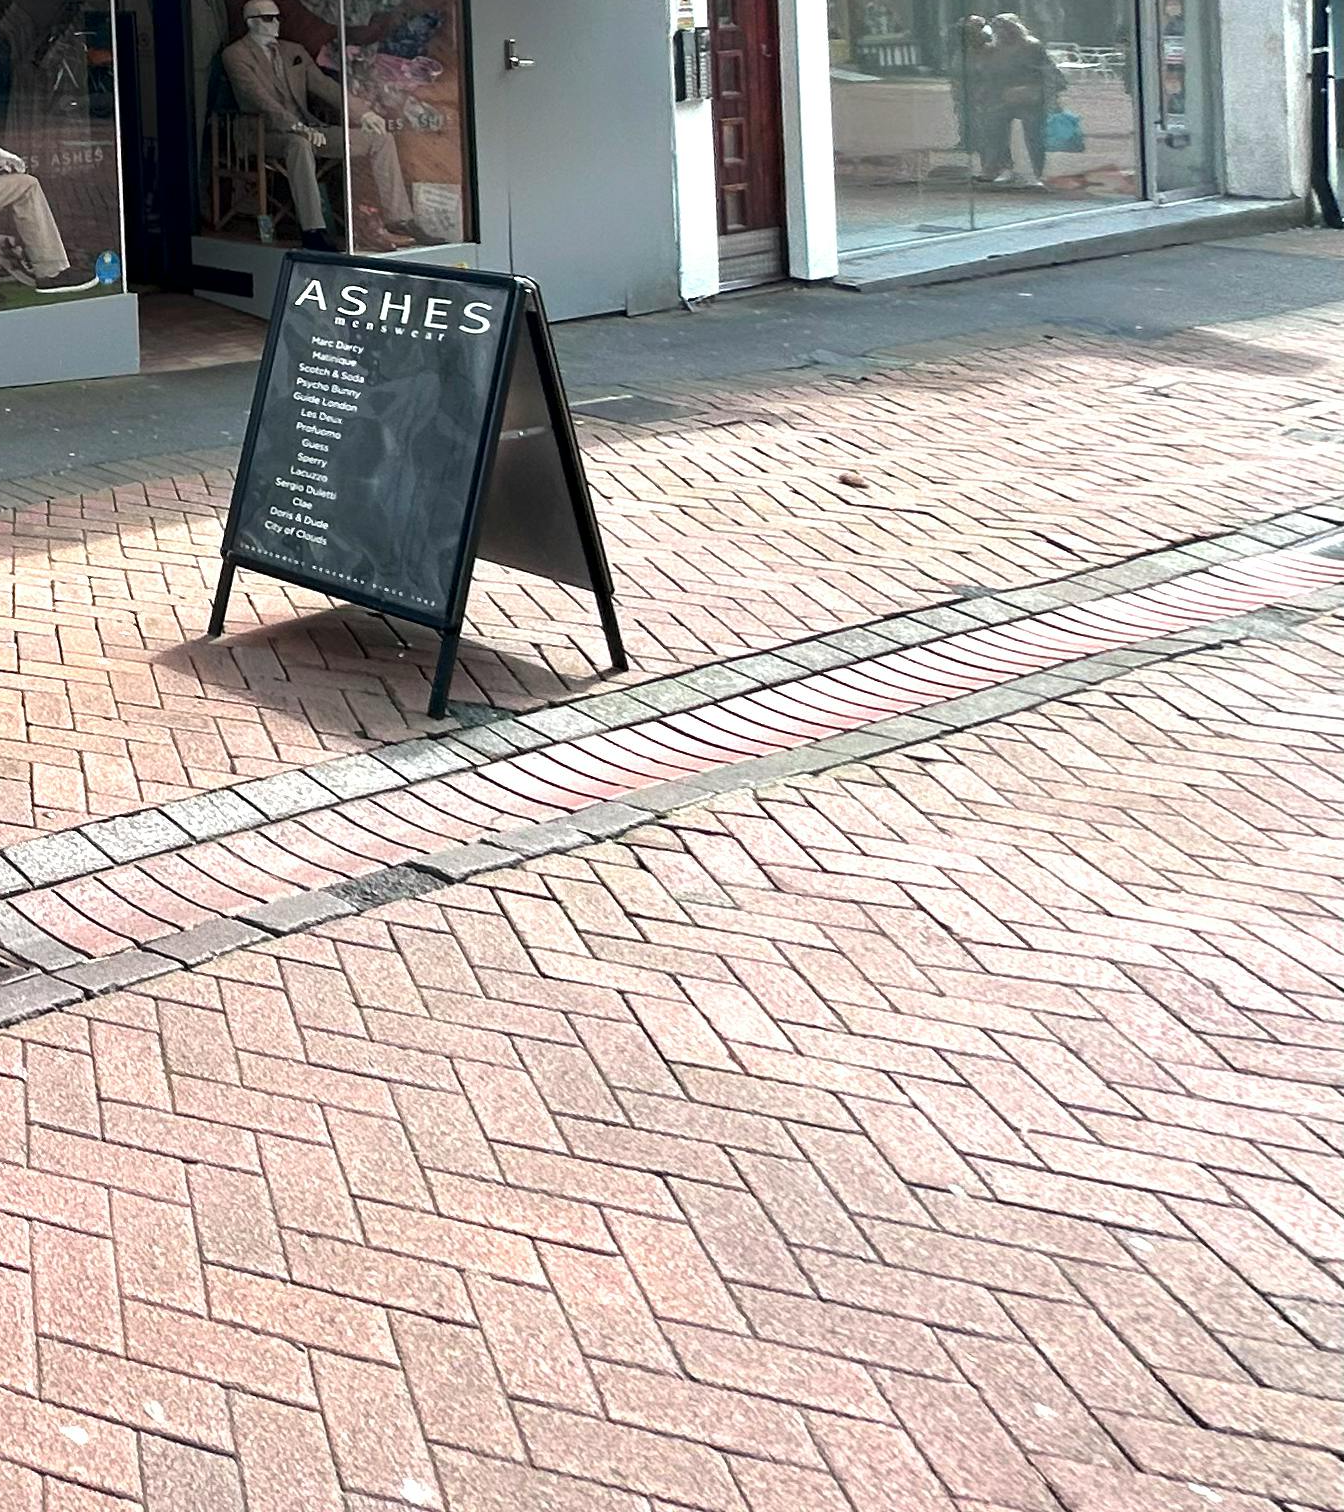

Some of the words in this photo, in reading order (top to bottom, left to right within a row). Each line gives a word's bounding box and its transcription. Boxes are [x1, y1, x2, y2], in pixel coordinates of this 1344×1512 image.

[51, 147, 104, 166] ASHES
[294, 279, 494, 334] ASHES
[334, 316, 446, 342] menswear
[312, 336, 335, 349] Marc
[336, 341, 365, 355] Darcy
[299, 362, 331, 377] Scotch
[332, 368, 340, 379] &
[341, 370, 365, 384] Soda
[296, 377, 330, 393] Psycho
[331, 384, 362, 400] Bunny
[293, 391, 321, 405] Guide
[322, 397, 358, 412] London
[300, 408, 317, 419] Les
[319, 412, 343, 424] Deux
[301, 438, 329, 452] Guess
[297, 452, 327, 468] Sperry
[274, 477, 305, 492] Sergio
[295, 513, 302, 522] &
[304, 515, 329, 529] Dude
[264, 520, 283, 533] City
[284, 526, 296, 536] of
[296, 529, 327, 546] Clouds
